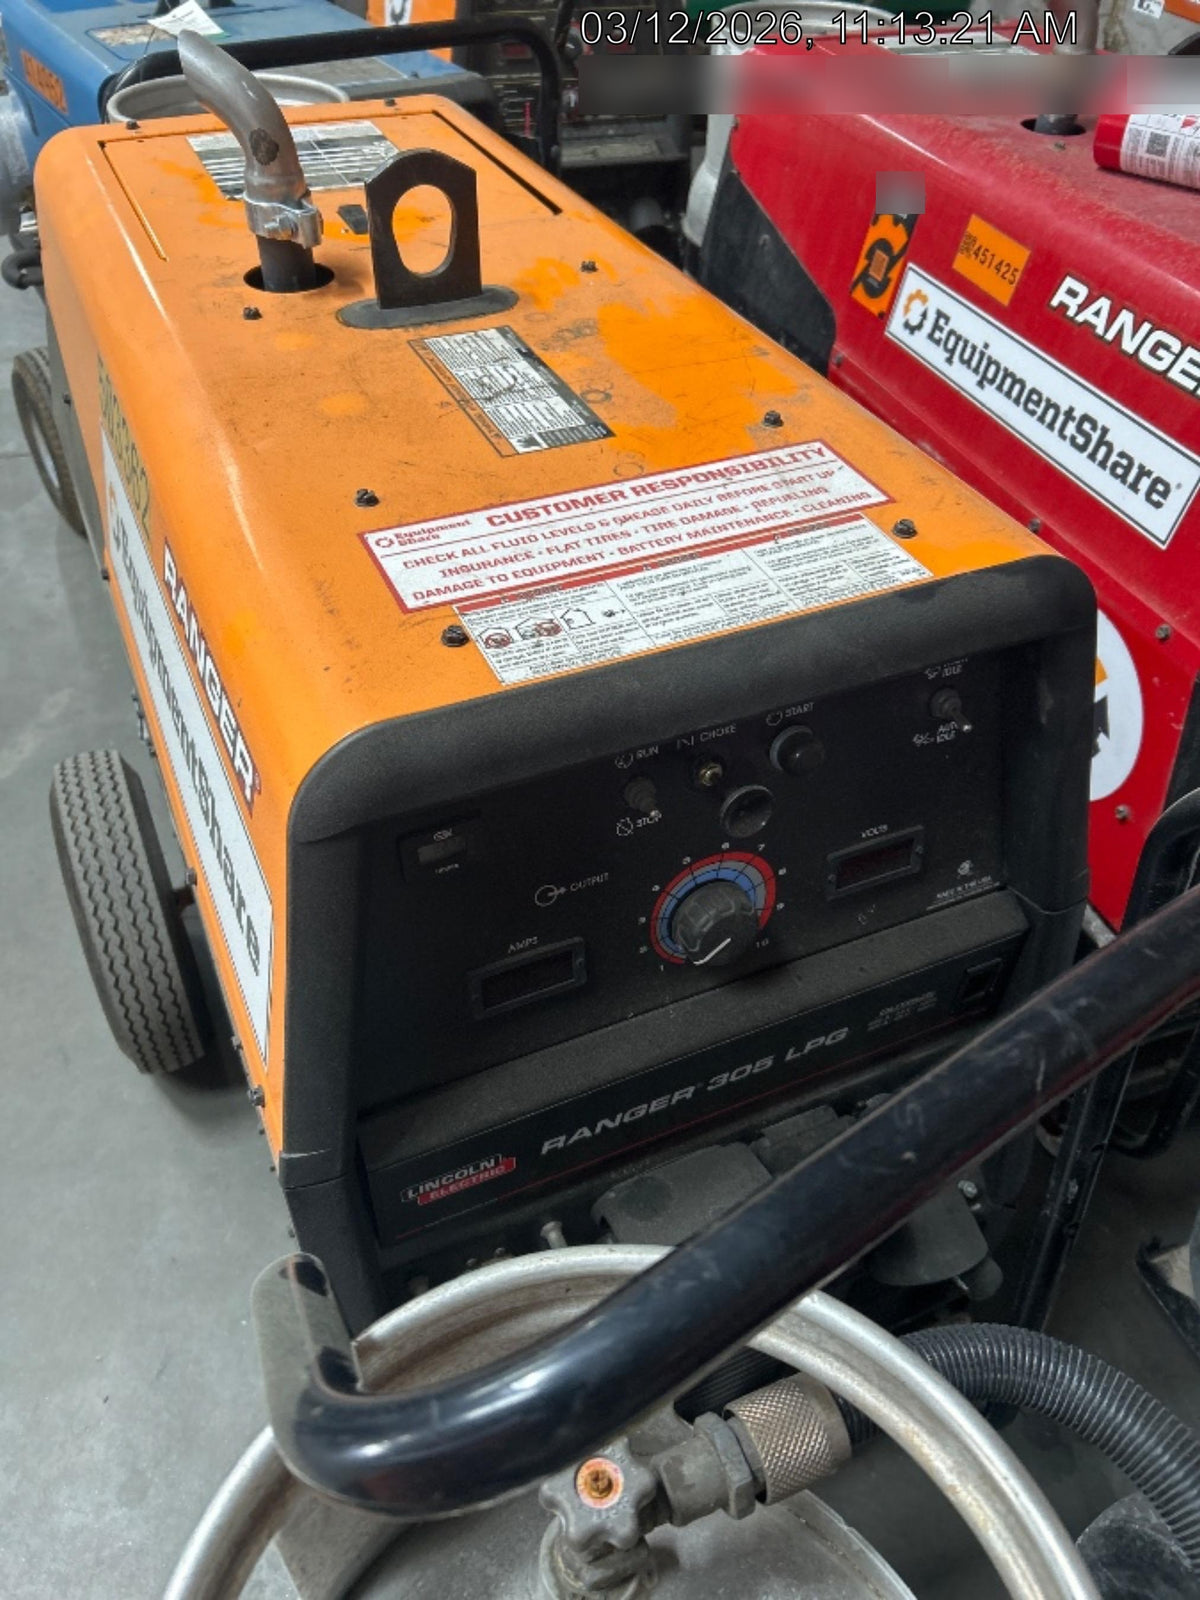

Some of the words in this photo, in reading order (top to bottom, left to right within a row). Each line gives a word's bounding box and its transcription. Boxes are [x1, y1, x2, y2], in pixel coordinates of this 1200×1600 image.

[972, 244, 1020, 287] 451425
[1050, 275, 1200, 398] RANGE
[927, 308, 1172, 510] EquipmentShare
[486, 489, 627, 527] CUSTOMER
[631, 446, 828, 497] RESPONSIBILITY
[394, 520, 472, 540] Equipment
[403, 552, 459, 570] CHECK
[461, 543, 491, 559] ALL
[492, 533, 540, 552] FLUID
[542, 521, 595, 541] LEVELS
[612, 504, 670, 527] GREASE
[673, 495, 714, 513] DAILY
[716, 483, 769, 503] BEFORE
[771, 472, 816, 490] START
[818, 469, 836, 481] UP
[439, 551, 536, 579] INSURANCE
[545, 539, 583, 557] FLAT
[585, 530, 632, 548] TIRES
[638, 517, 678, 535] TIRE
[680, 505, 742, 527] DAMAGE
[751, 486, 830, 511] REFUELING
[413, 579, 485, 601] DAMAGE
[488, 572, 510, 585] TO
[511, 552, 606, 581] EQUIPMENT
[617, 533, 684, 556] BATTERY
[686, 510, 793, 540] MAINTENANCE
[801, 491, 873, 514] CLEANING
[163, 540, 255, 806] RANGER
[785, 702, 815, 718] START
[635, 745, 659, 761] RUN
[700, 724, 737, 742] CHOKE
[861, 824, 888, 838] VOLTS
[570, 872, 609, 892] OUTPUT
[507, 935, 538, 953] AMPS
[541, 1085, 697, 1155] RANGER
[706, 1055, 774, 1092] 305
[785, 1027, 849, 1062] LPG
[408, 1158, 495, 1200] LINCOLN
[430, 1166, 506, 1199] ELECTRIC
